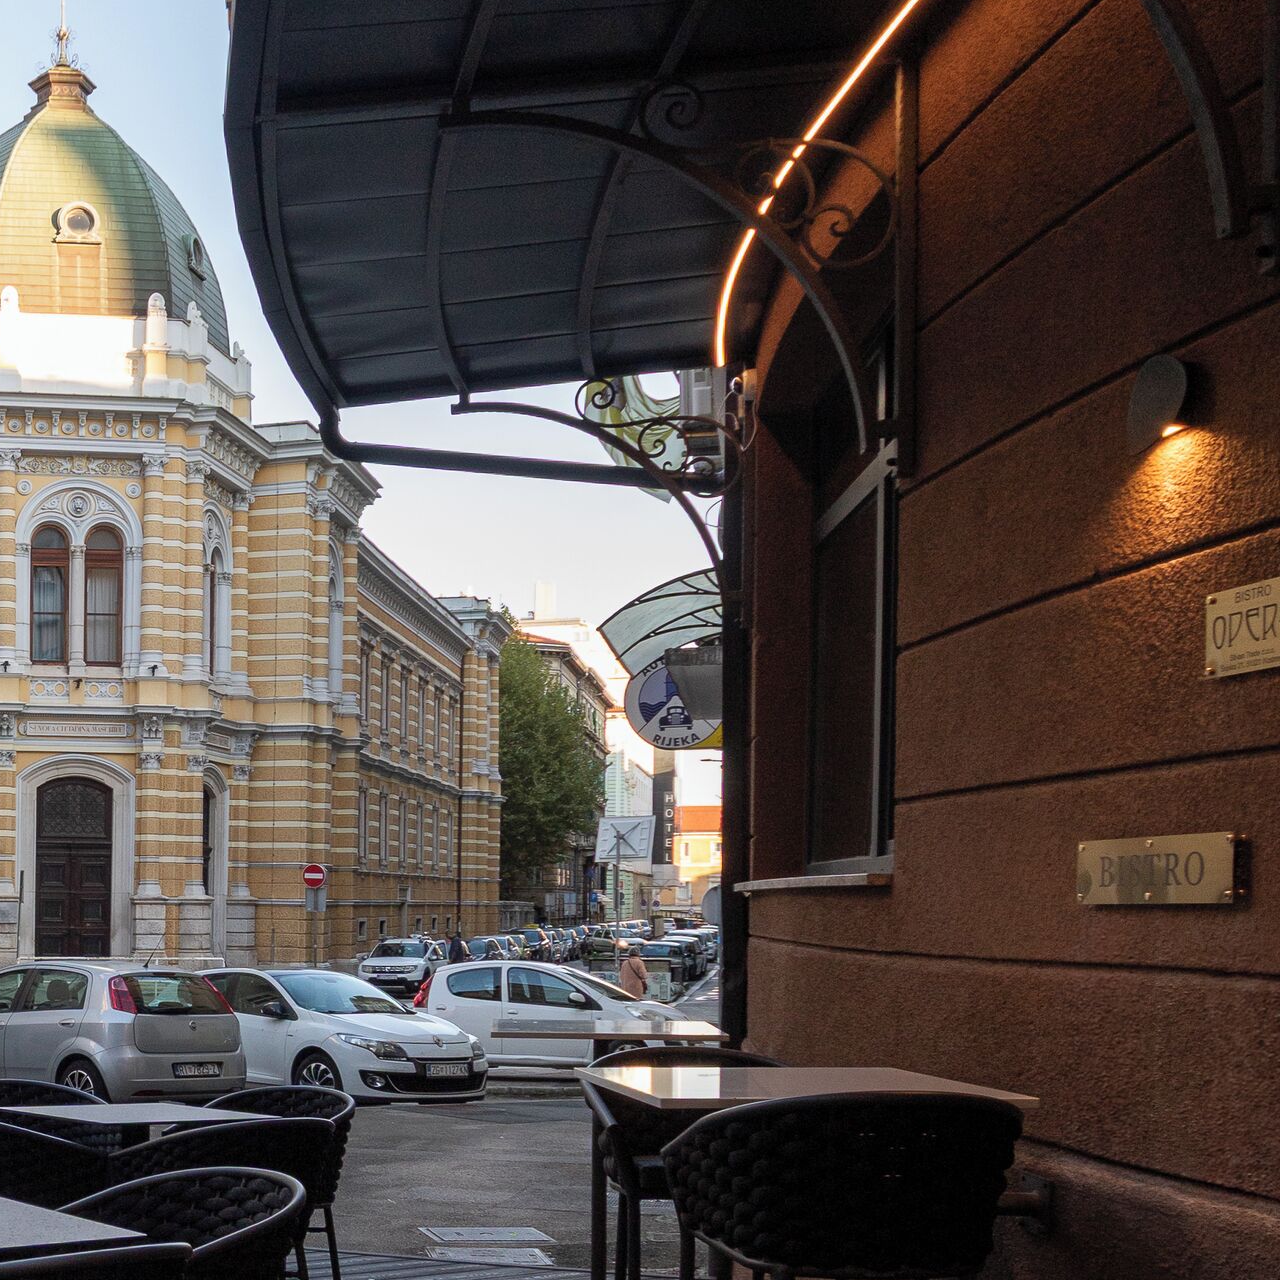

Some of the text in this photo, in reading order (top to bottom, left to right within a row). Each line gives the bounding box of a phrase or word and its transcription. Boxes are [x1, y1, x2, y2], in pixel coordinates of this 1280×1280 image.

[1235, 584, 1272, 604] BISTRO
[1213, 603, 1280, 650] OPER
[652, 733, 701, 747] RIJEKA
[665, 794, 674, 862] HOTEL
[1098, 851, 1205, 888] BISTRO
